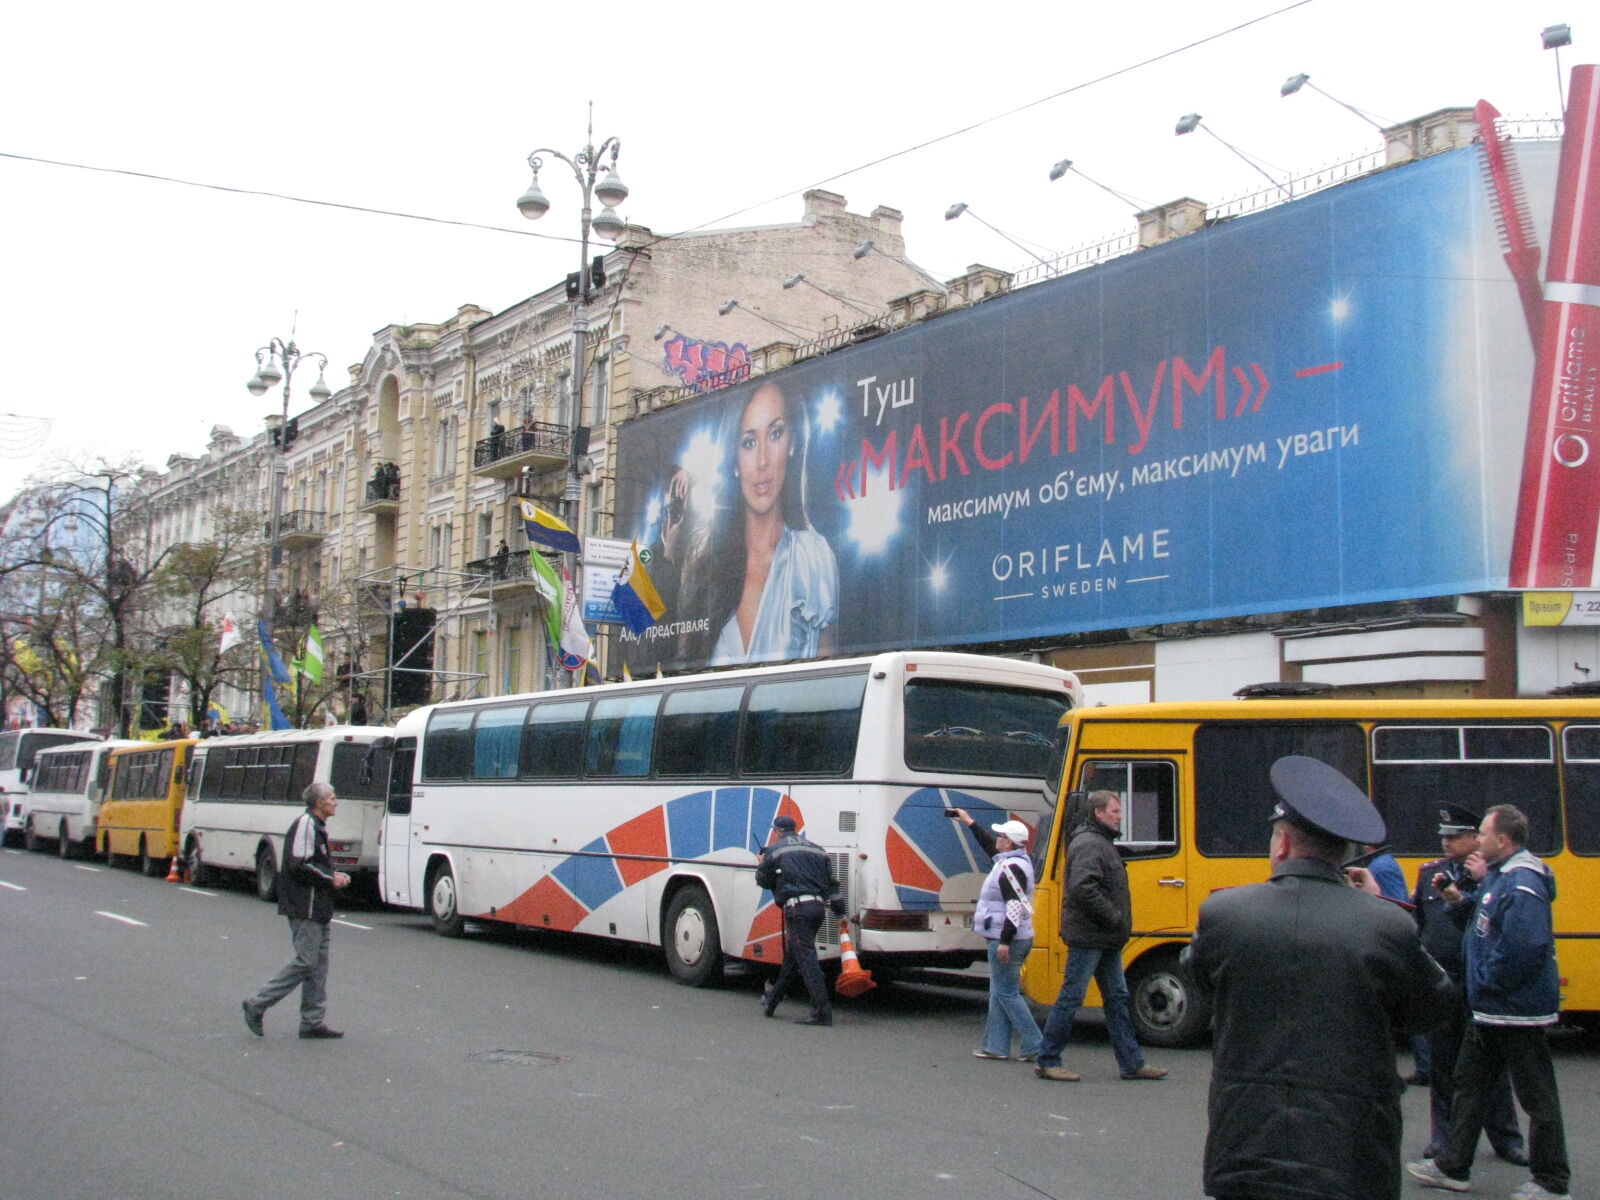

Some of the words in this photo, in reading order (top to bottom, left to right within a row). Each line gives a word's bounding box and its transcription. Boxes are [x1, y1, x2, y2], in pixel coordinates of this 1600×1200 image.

[1558, 325, 1587, 422] oriflame
[834, 345, 1270, 501] «МАКСИМУМ»
[857, 376, 915, 425] Туш
[928, 488, 1031, 525] максимум
[1132, 441, 1266, 488] максимум
[1277, 423, 1360, 468] уваги
[991, 529, 1171, 582] ORIFLAME
[1041, 576, 1118, 600] SWEDEN
[645, 618, 710, 643] представляє
